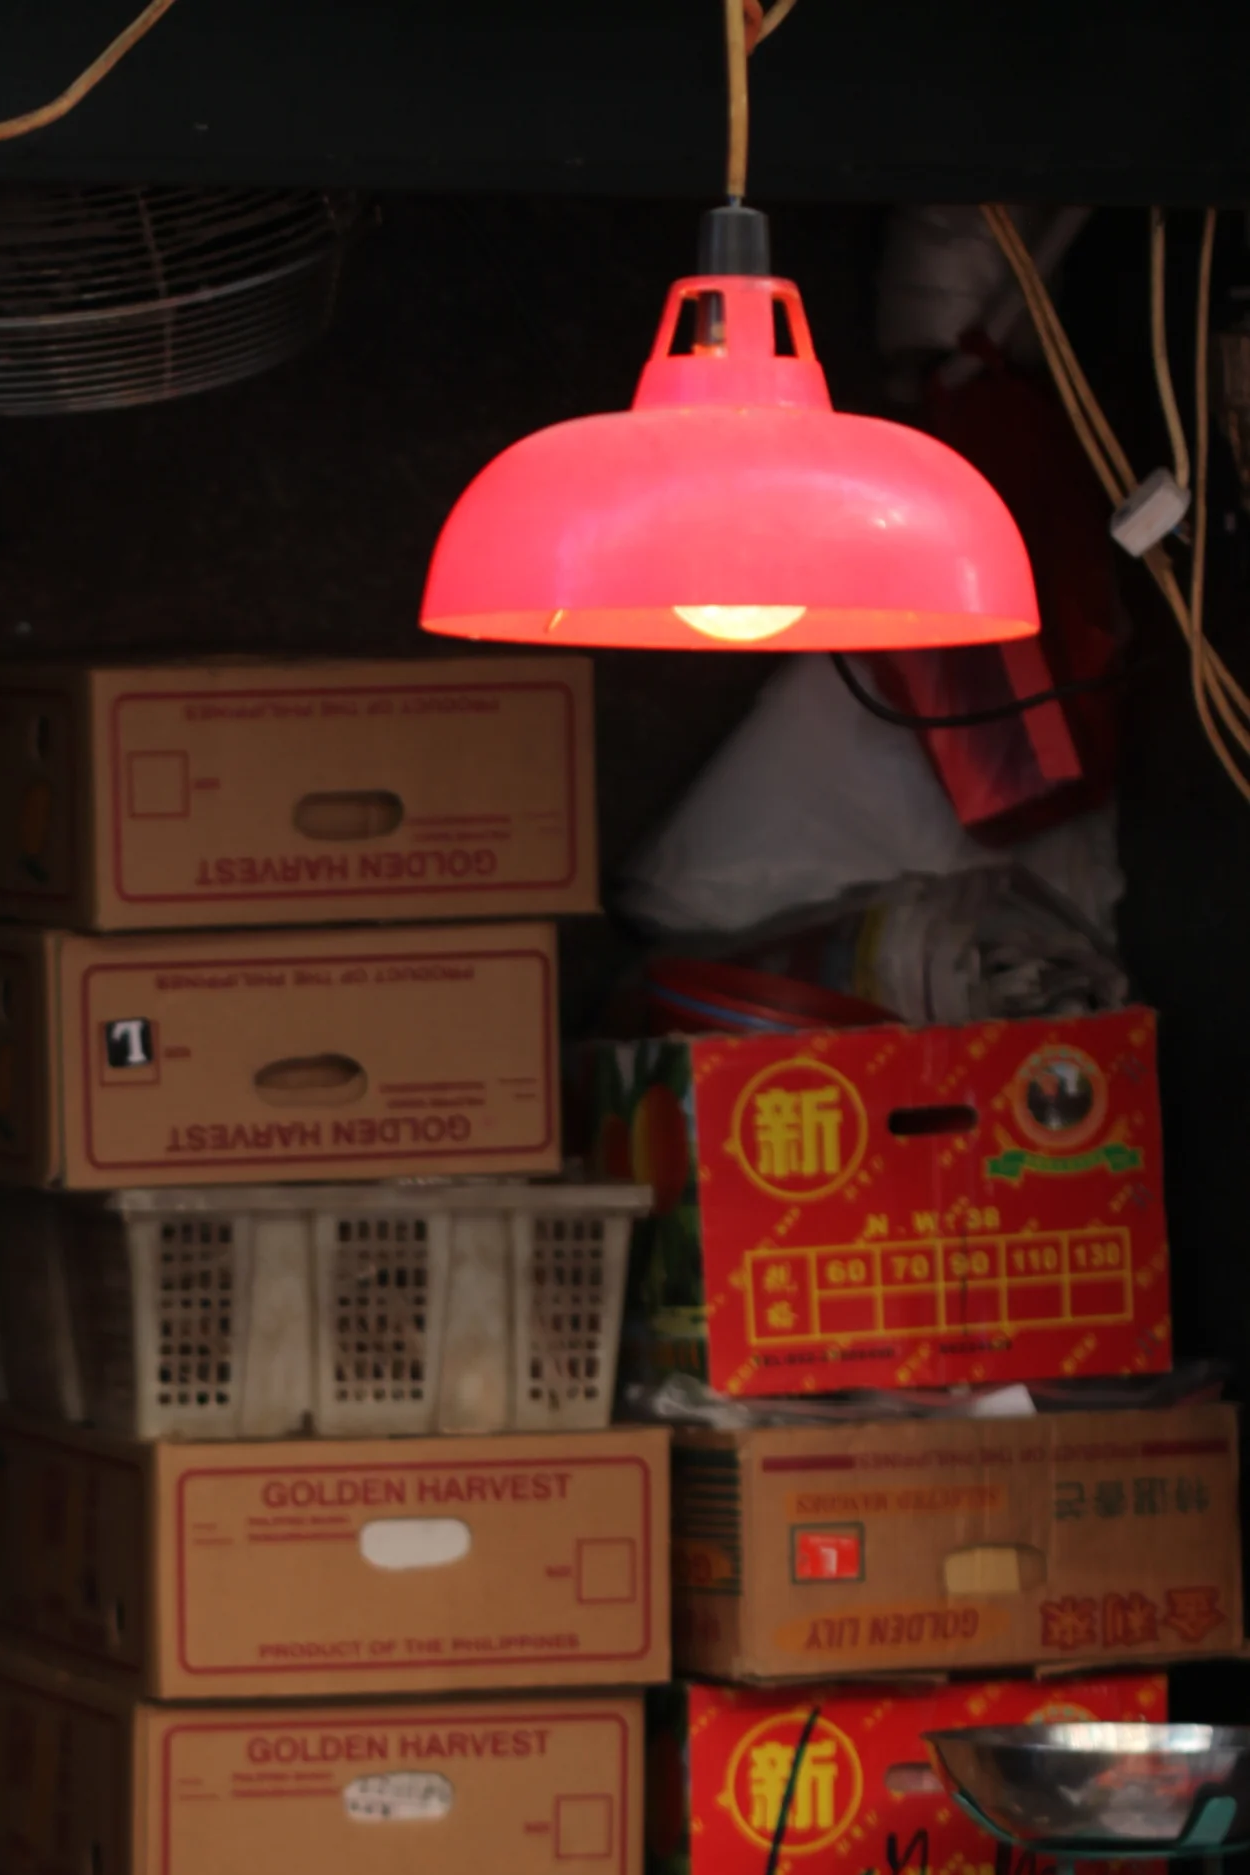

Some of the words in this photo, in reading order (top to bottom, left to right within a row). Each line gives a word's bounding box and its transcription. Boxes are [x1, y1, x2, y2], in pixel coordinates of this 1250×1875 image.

[195, 855, 348, 886] HARVEST
[357, 848, 496, 880] GOLDEN
[165, 1122, 320, 1153] HARVEST
[332, 1114, 471, 1146] GOLDEN
[753, 1085, 843, 1178] 新
[1013, 1246, 1058, 1271] 110
[1075, 1242, 1121, 1267] 130
[261, 1477, 407, 1509] GOLDEN
[418, 1473, 572, 1502] HARVEST
[869, 1609, 979, 1646] GOLDEN
[247, 1735, 388, 1764] GOLDEN
[400, 1729, 551, 1758] HARVEST
[748, 1738, 838, 1831] 新
